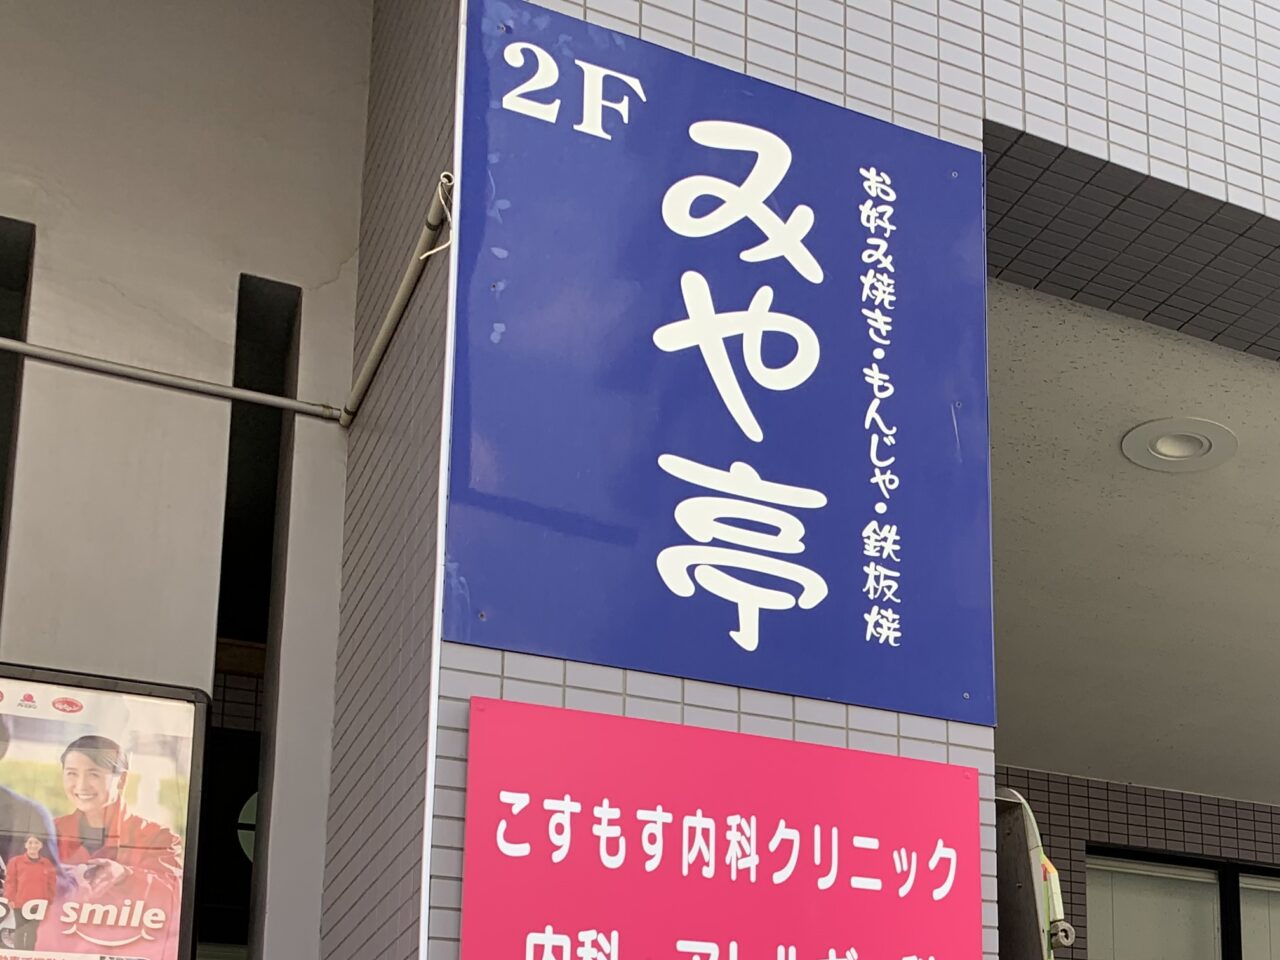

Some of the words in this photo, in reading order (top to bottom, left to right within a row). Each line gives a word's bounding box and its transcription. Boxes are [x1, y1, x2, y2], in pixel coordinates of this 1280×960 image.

[501, 41, 647, 141] 2F
[653, 120, 829, 651] みや亭
[858, 166, 901, 647] お好み焼き・もんじゃ・鉄板焼
[496, 790, 958, 901] こすもす内科クリニック
[21, 898, 48, 921] a
[60, 899, 166, 929] smile
